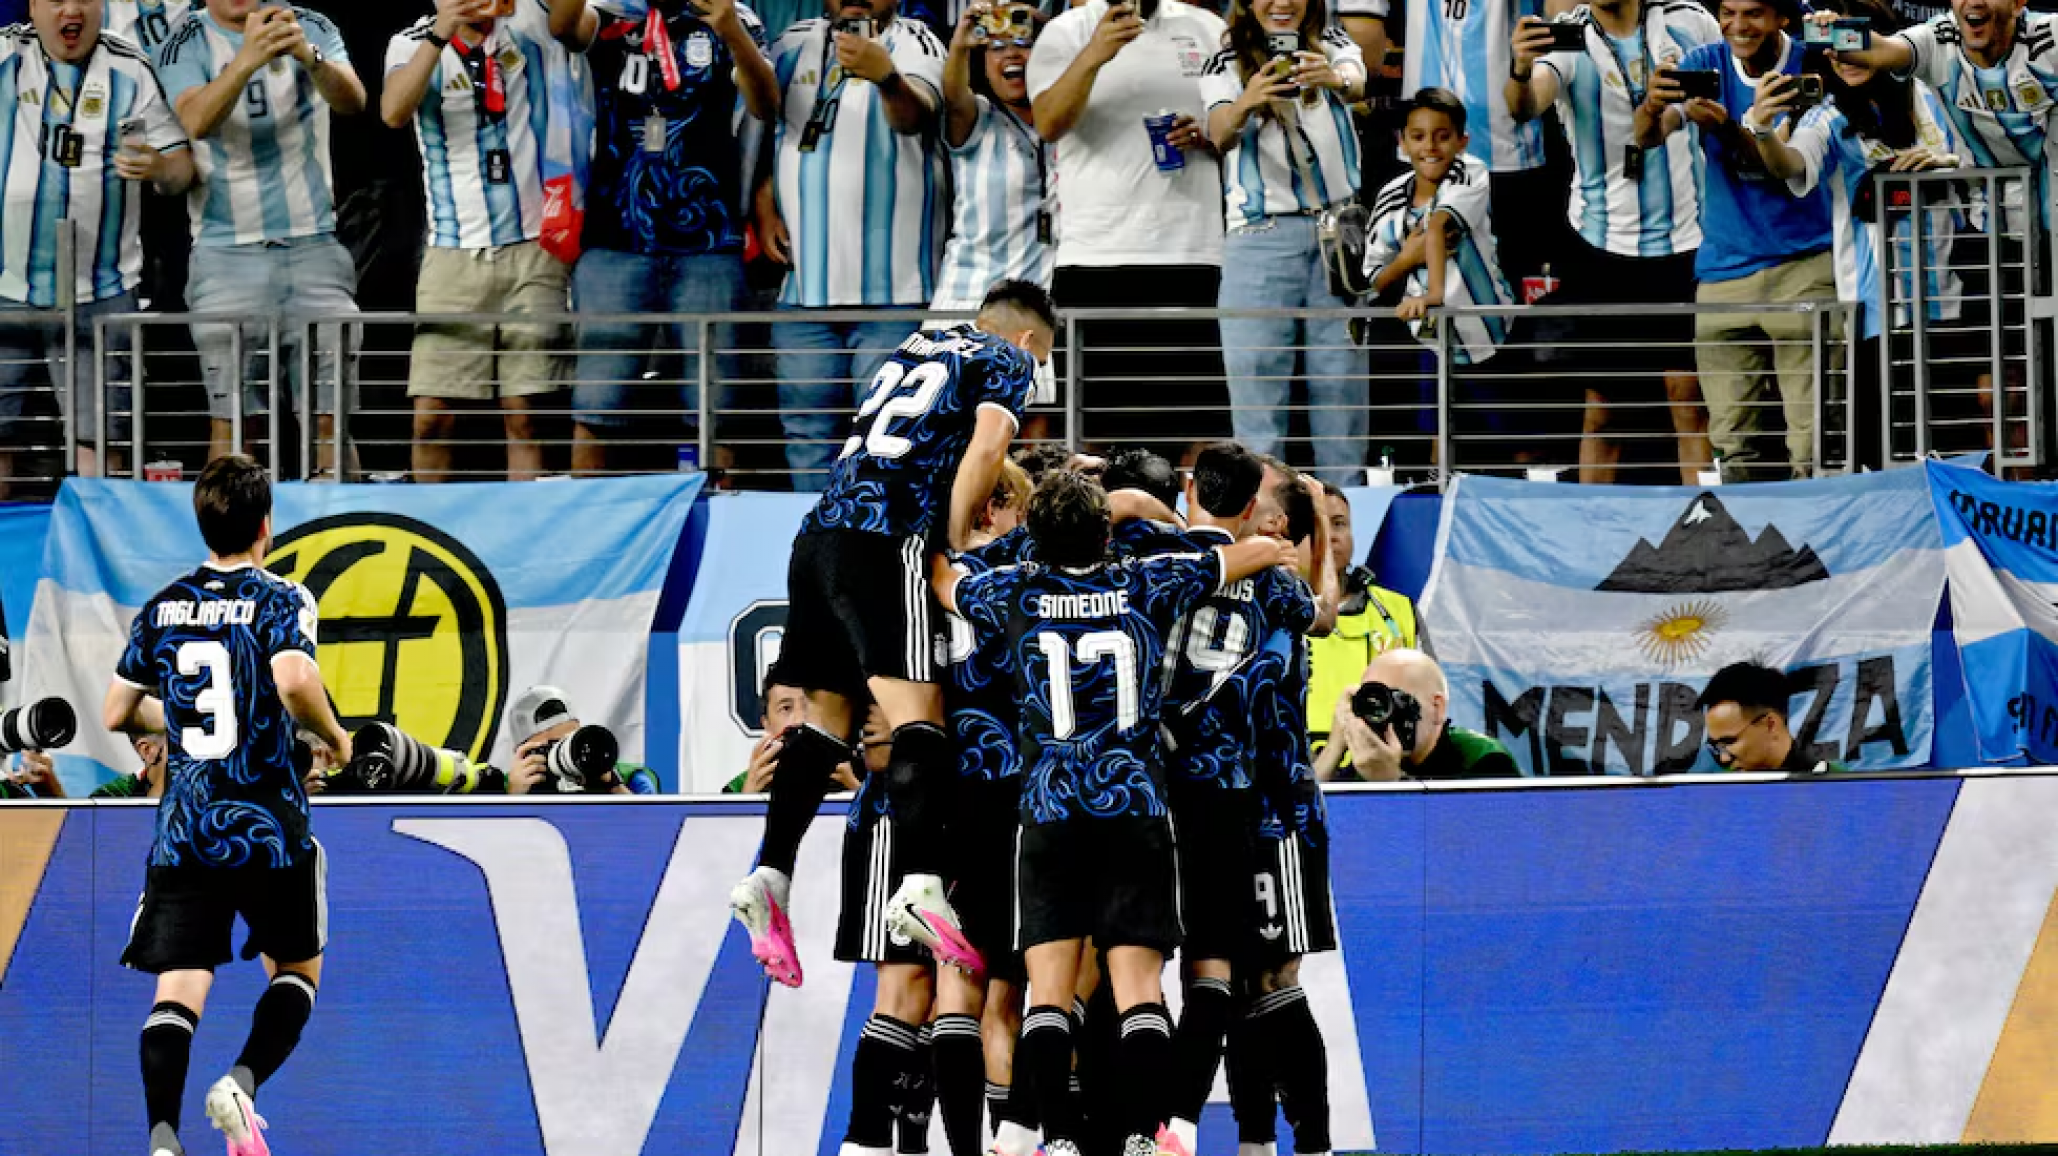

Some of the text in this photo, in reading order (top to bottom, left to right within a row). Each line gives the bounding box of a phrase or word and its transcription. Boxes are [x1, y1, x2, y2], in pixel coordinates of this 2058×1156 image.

[247, 80, 267, 118] 9
[838, 361, 949, 459] 22
[156, 600, 256, 628] TAGLIAFICO
[1039, 590, 1131, 619] SIMEONE
[176, 641, 239, 760] 3
[1038, 631, 1138, 741] 17
[1482, 655, 1909, 778] MENDZA
[1254, 872, 1277, 918] 9
